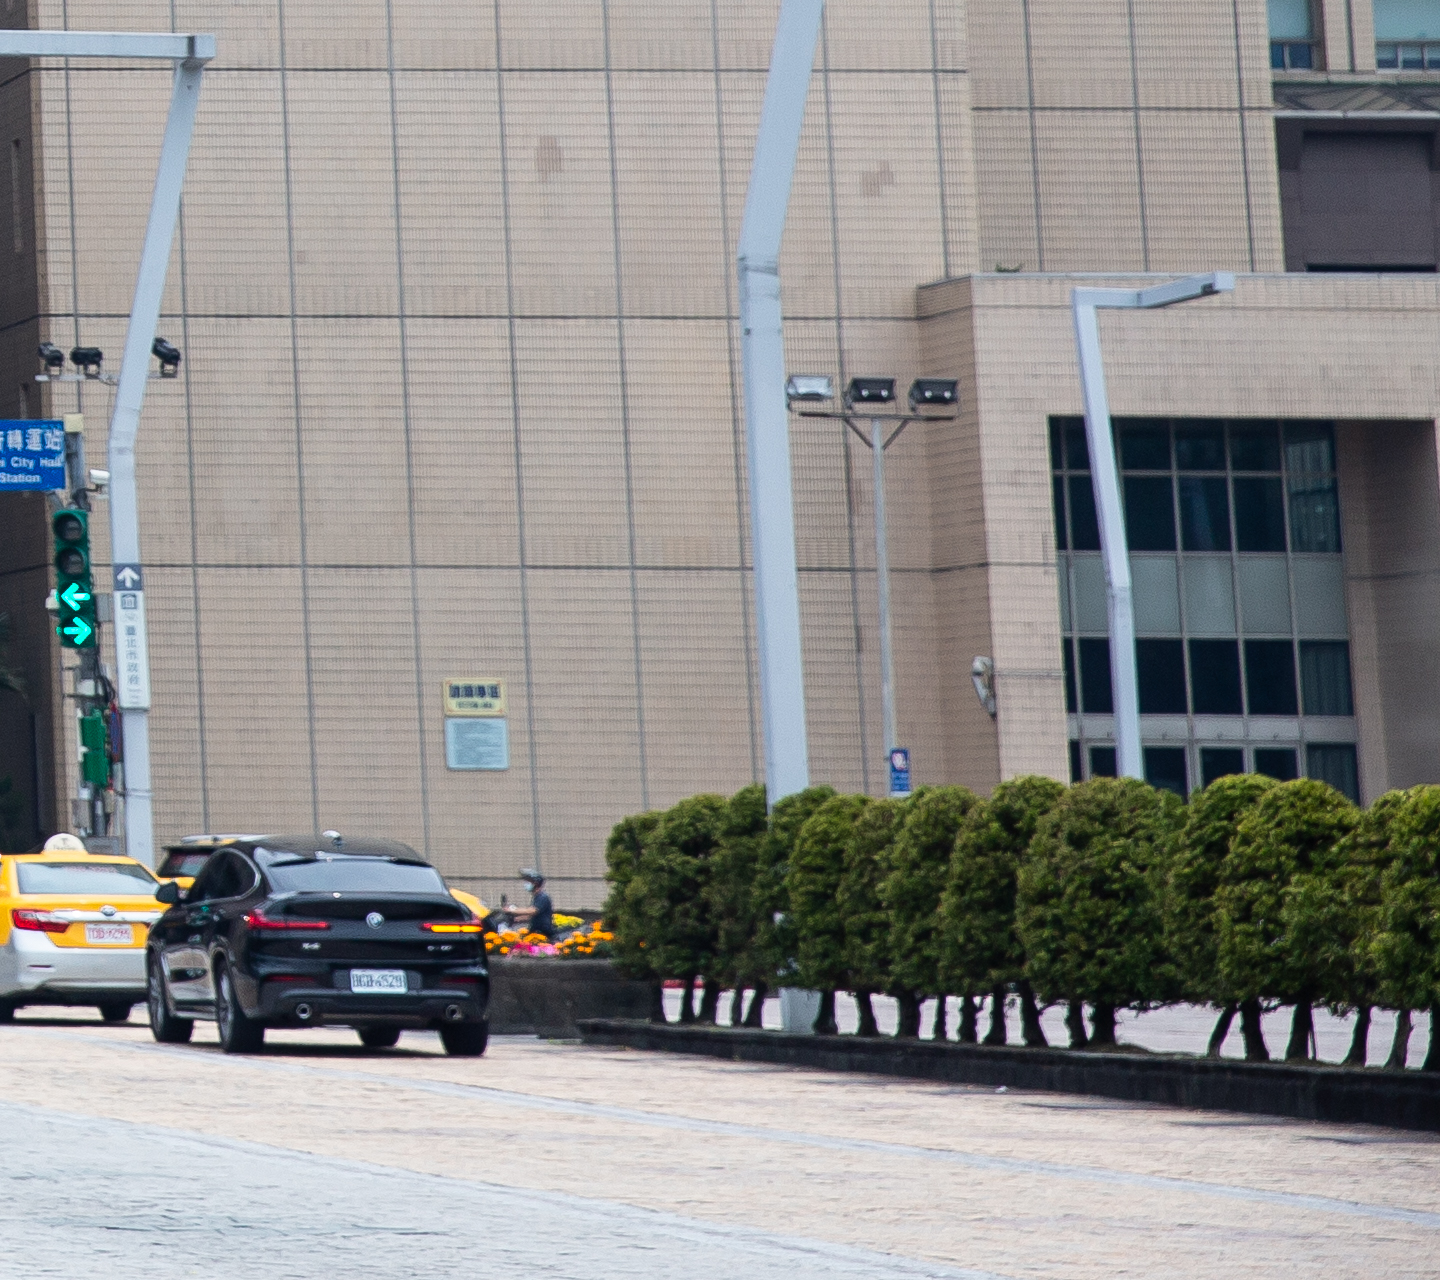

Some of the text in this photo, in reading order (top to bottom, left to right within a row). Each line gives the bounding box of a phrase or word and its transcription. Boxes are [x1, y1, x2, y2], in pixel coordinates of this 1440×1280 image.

[10, 456, 35, 470] City
[40, 456, 64, 468] Hall
[0, 472, 41, 484] Station
